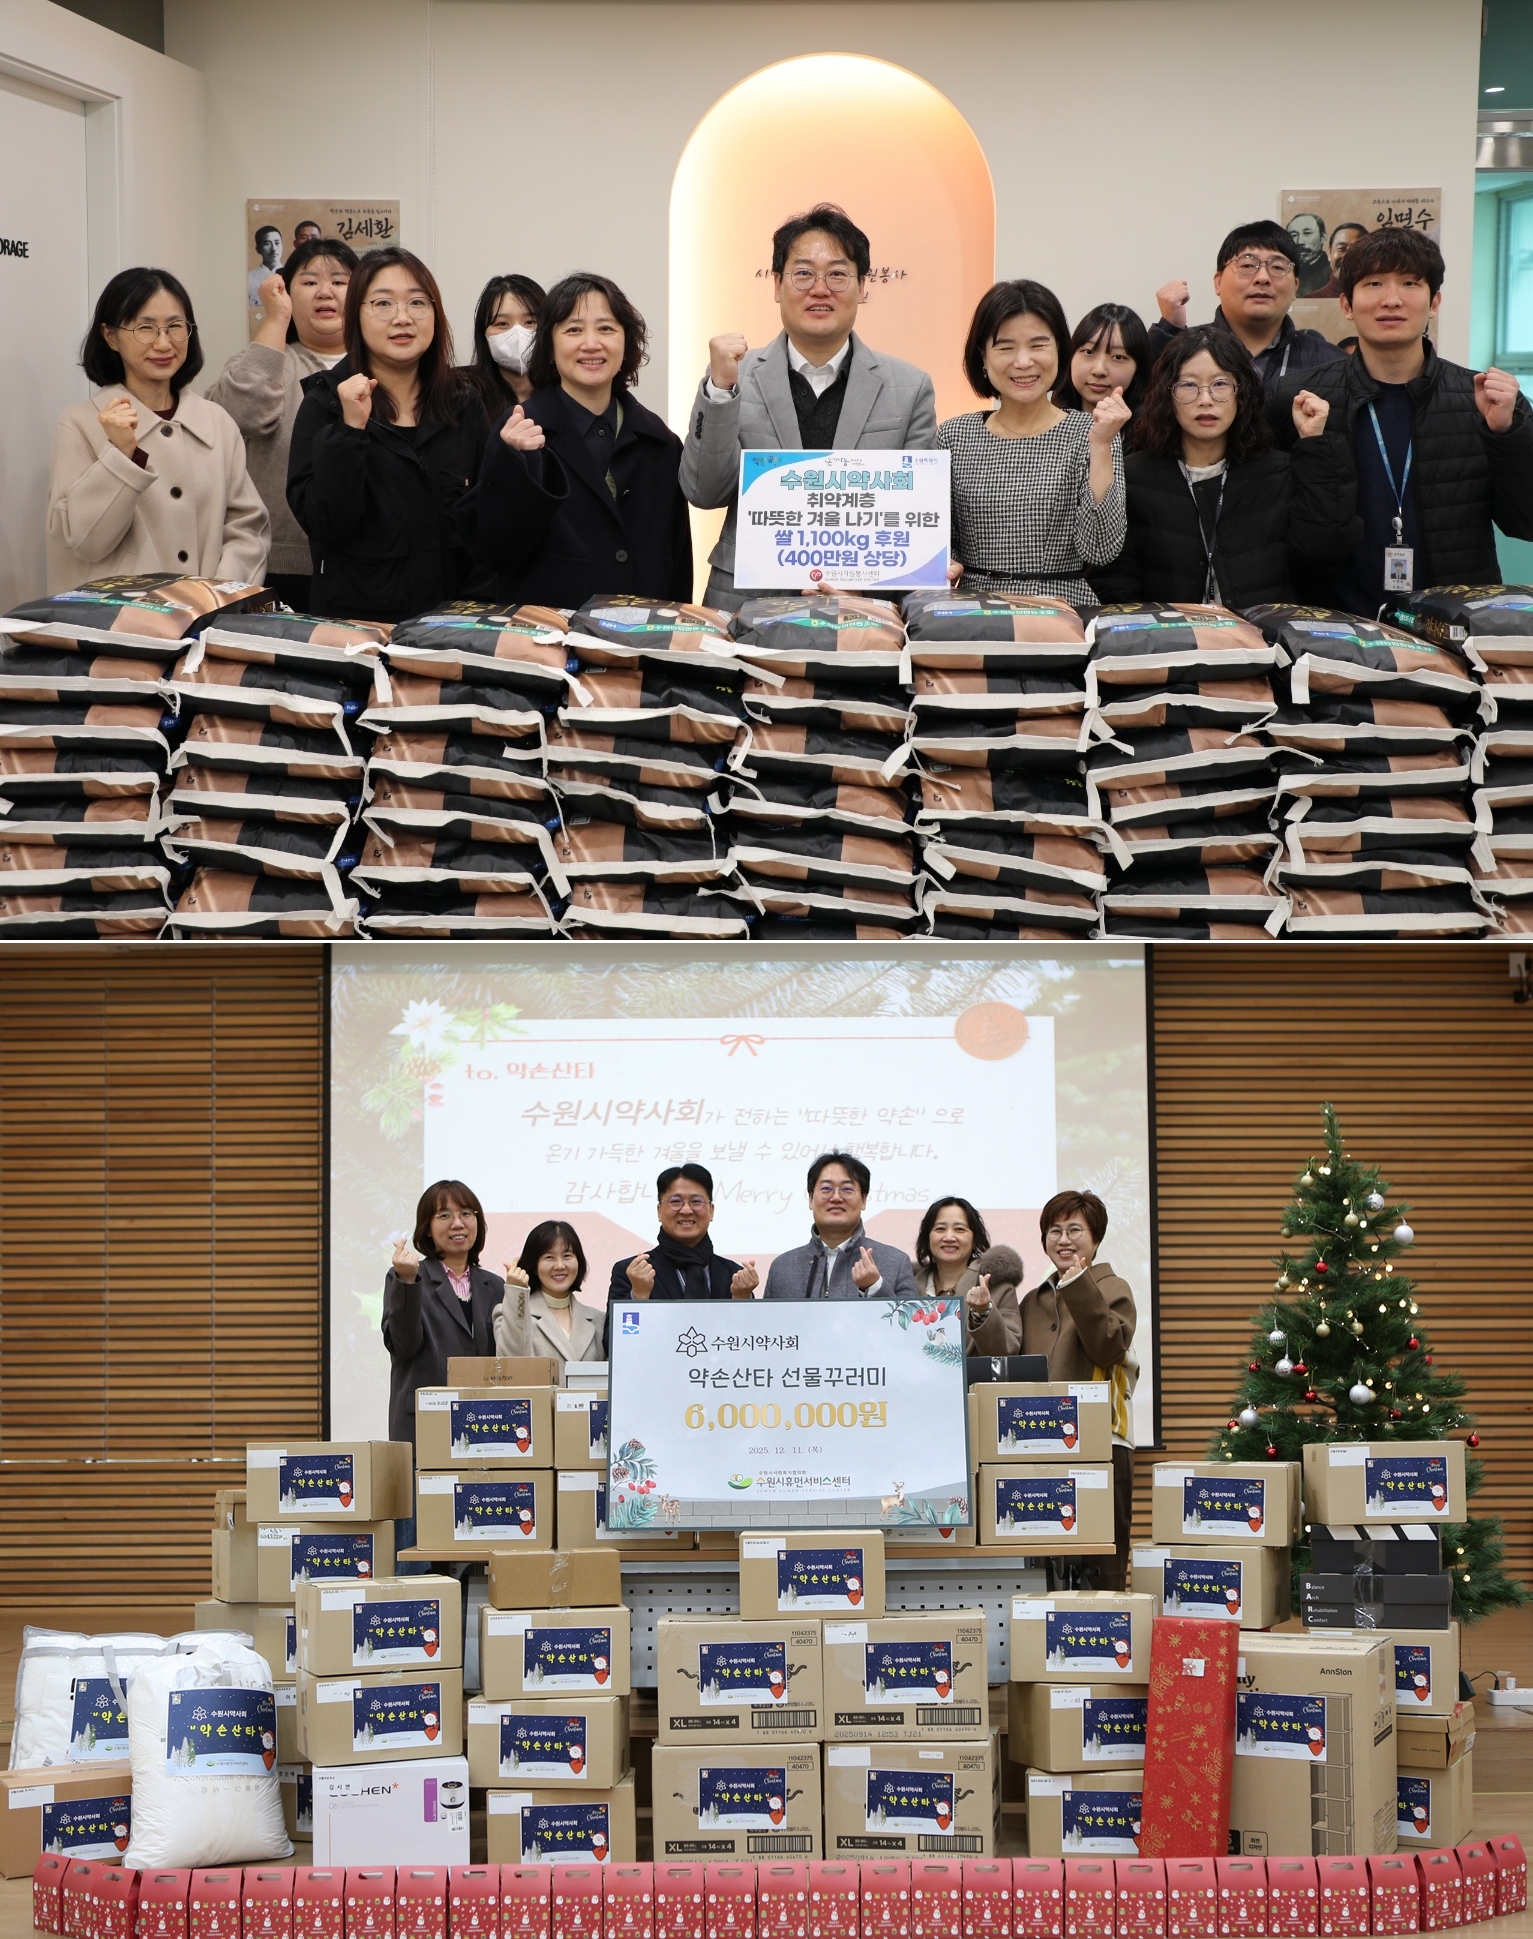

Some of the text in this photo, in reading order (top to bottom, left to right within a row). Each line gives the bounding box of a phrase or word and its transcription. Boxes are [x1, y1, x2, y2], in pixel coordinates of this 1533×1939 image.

[337, 217, 394, 241] 김세환
[780, 469, 914, 491] 수원시약사회
[807, 492, 876, 509] 취약계층
[748, 510, 940, 528] '따뜻한 겨울 나기'를 위한
[774, 529, 910, 550] 쌀 1,100kg 후원
[777, 549, 907, 568] (400만원 상당)
[464, 1061, 596, 1080] to. 약손산타
[520, 1098, 965, 1127] 수원시약사회가 전하는 "따뜻한 약손" 으로
[545, 1143, 580, 1164] 온기
[587, 1143, 645, 1163] 가득한
[653, 1141, 703, 1163] 겨울을
[709, 1141, 748, 1162] 보낼
[754, 1143, 772, 1161] 수
[845, 1141, 939, 1162] 행복합니다.
[714, 1179, 794, 1209] Merry
[711, 1334, 800, 1352] 수원시약사회
[688, 1366, 887, 1389] 약손산타 선물꾸러미
[684, 1401, 888, 1431] 6,000,000원
[792, 1446, 804, 1454] 11.
[807, 1446, 823, 1454] (목)
[756, 1476, 851, 1488] 수원시휴먼서비스센터
[1305, 1582, 1325, 1590] Balance
[1307, 1605, 1339, 1613] Rehabilitation
[1307, 1615, 1328, 1623] Comfort
[210, 1709, 248, 1718] 수원시약사회
[838, 1714, 852, 1724] XL
[673, 1719, 687, 1728] XL
[834, 1730, 873, 1738] 20250914
[877, 1730, 899, 1738] 12:53
[668, 1843, 683, 1852] XL
[840, 1838, 854, 1847] XL
